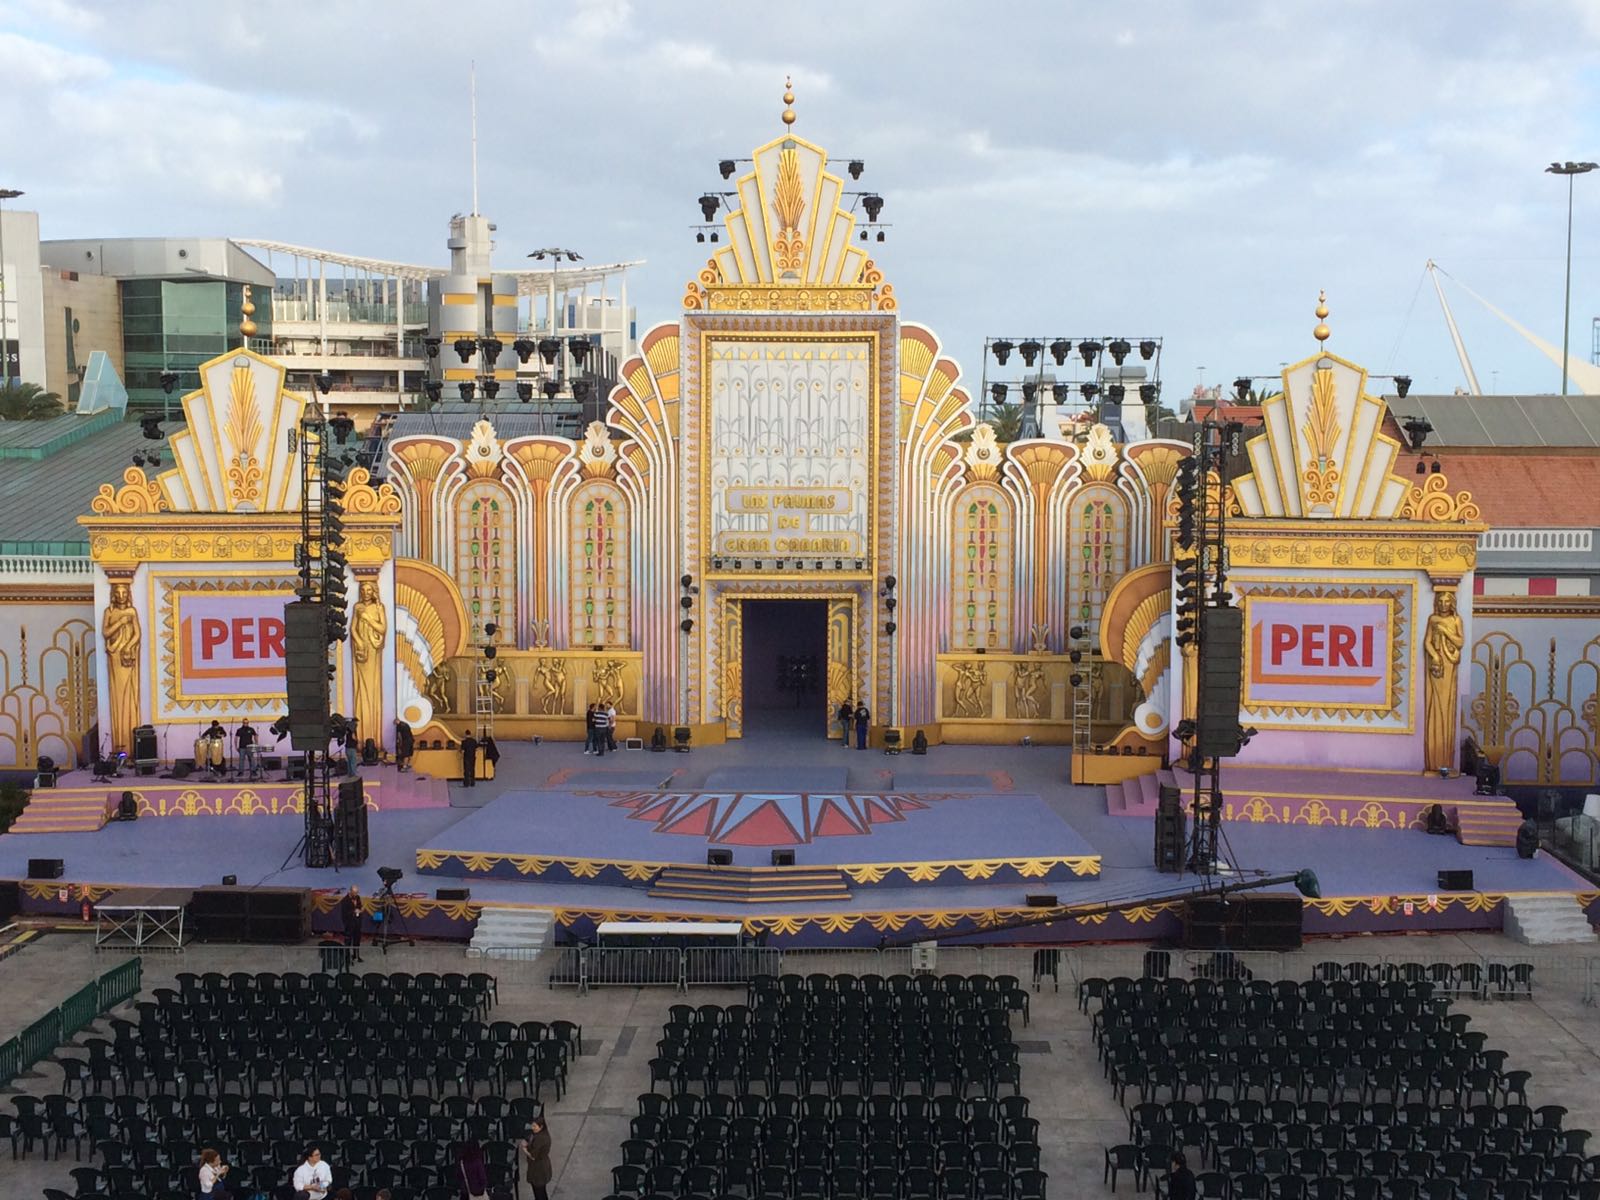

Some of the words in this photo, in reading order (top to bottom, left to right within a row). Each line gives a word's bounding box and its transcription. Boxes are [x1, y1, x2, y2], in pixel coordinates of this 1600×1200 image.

[778, 515, 800, 529] DE
[201, 617, 286, 660] PER
[1271, 623, 1374, 667] PERI
